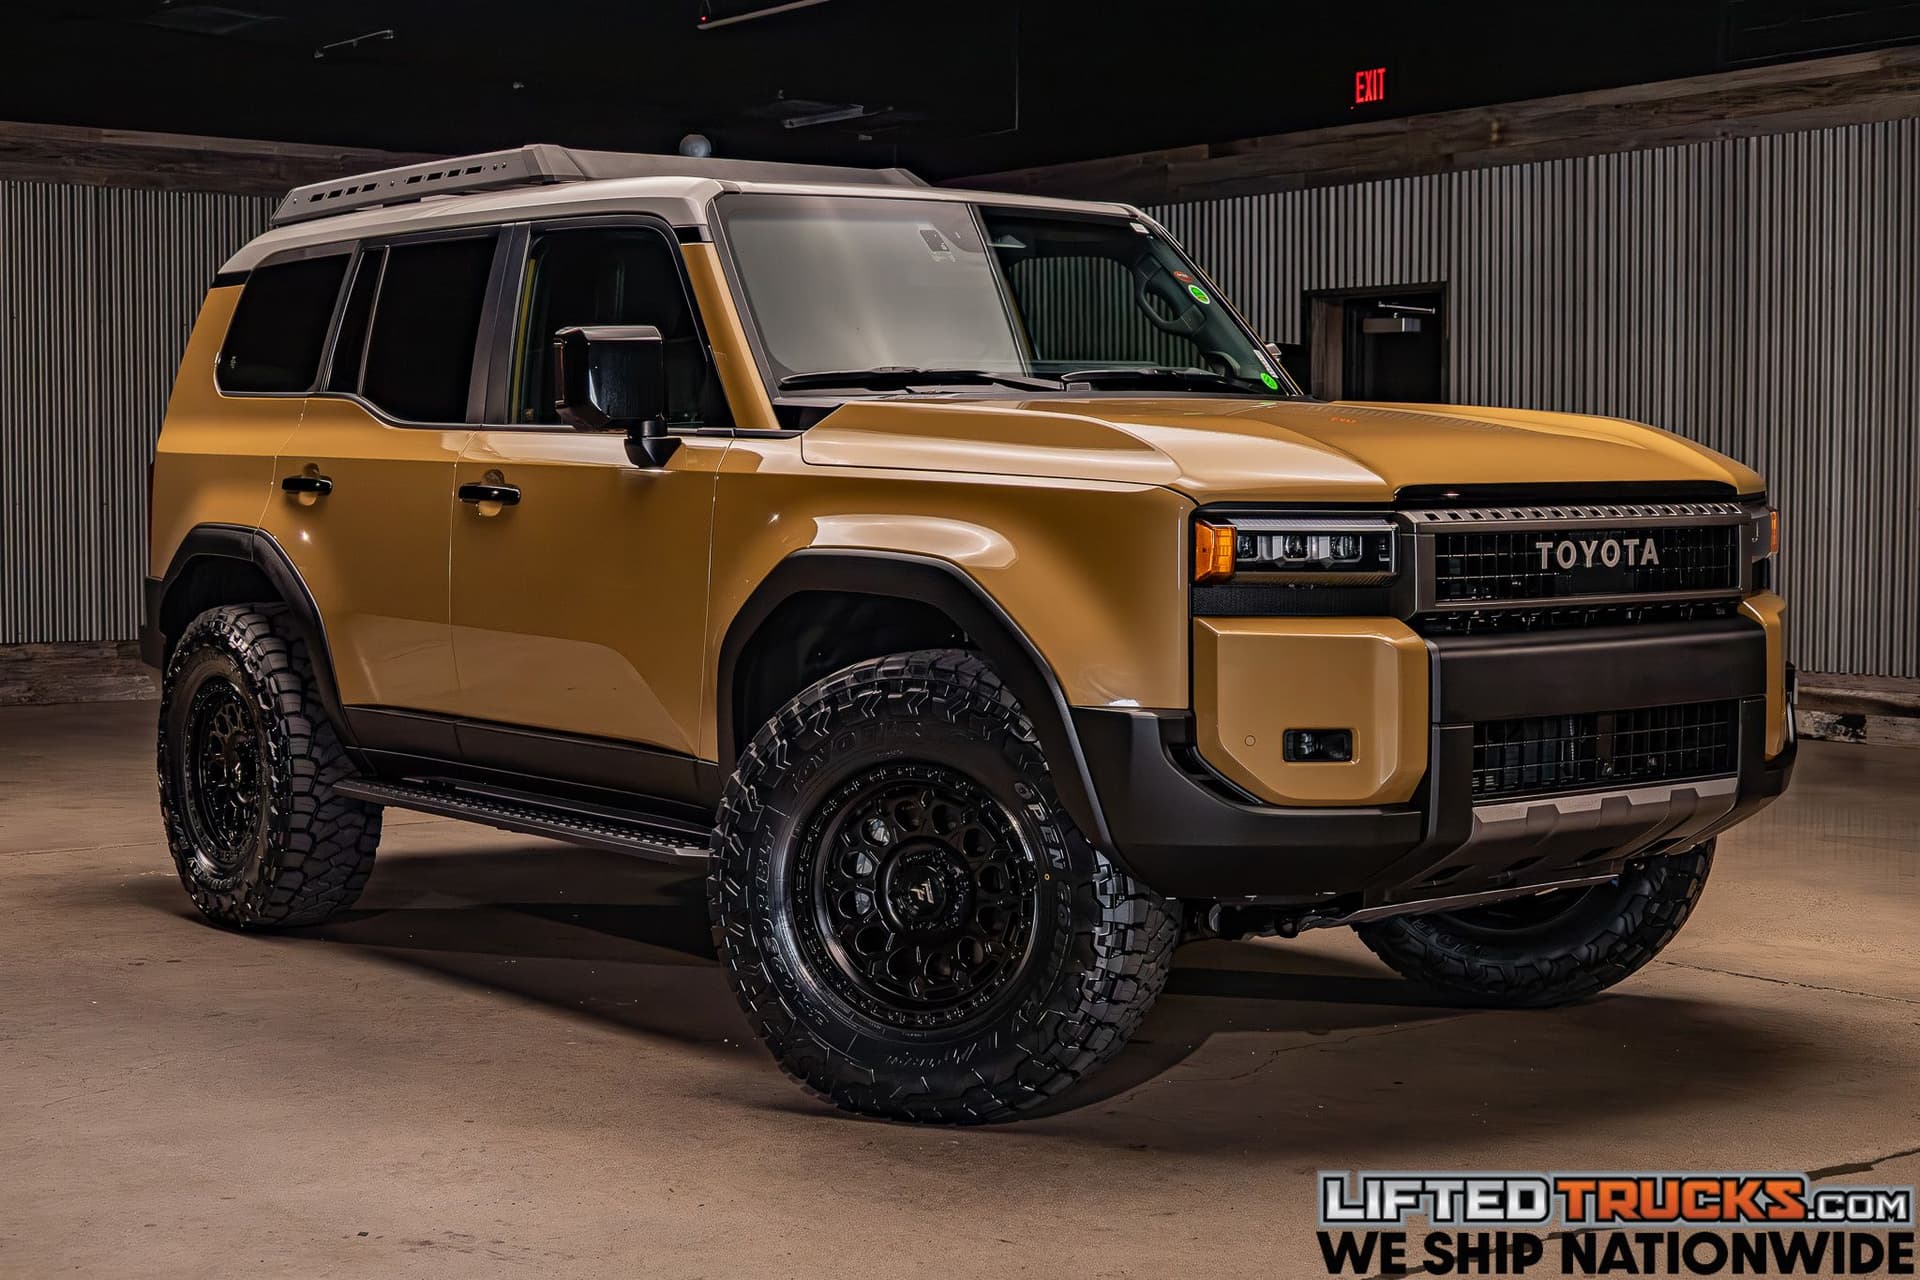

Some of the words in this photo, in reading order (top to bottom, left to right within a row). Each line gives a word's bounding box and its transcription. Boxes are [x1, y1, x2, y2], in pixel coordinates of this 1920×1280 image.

[1354, 67, 1386, 104] EXIT
[1535, 538, 1660, 570] TOYOTA
[1014, 781, 1066, 870] OPEN
